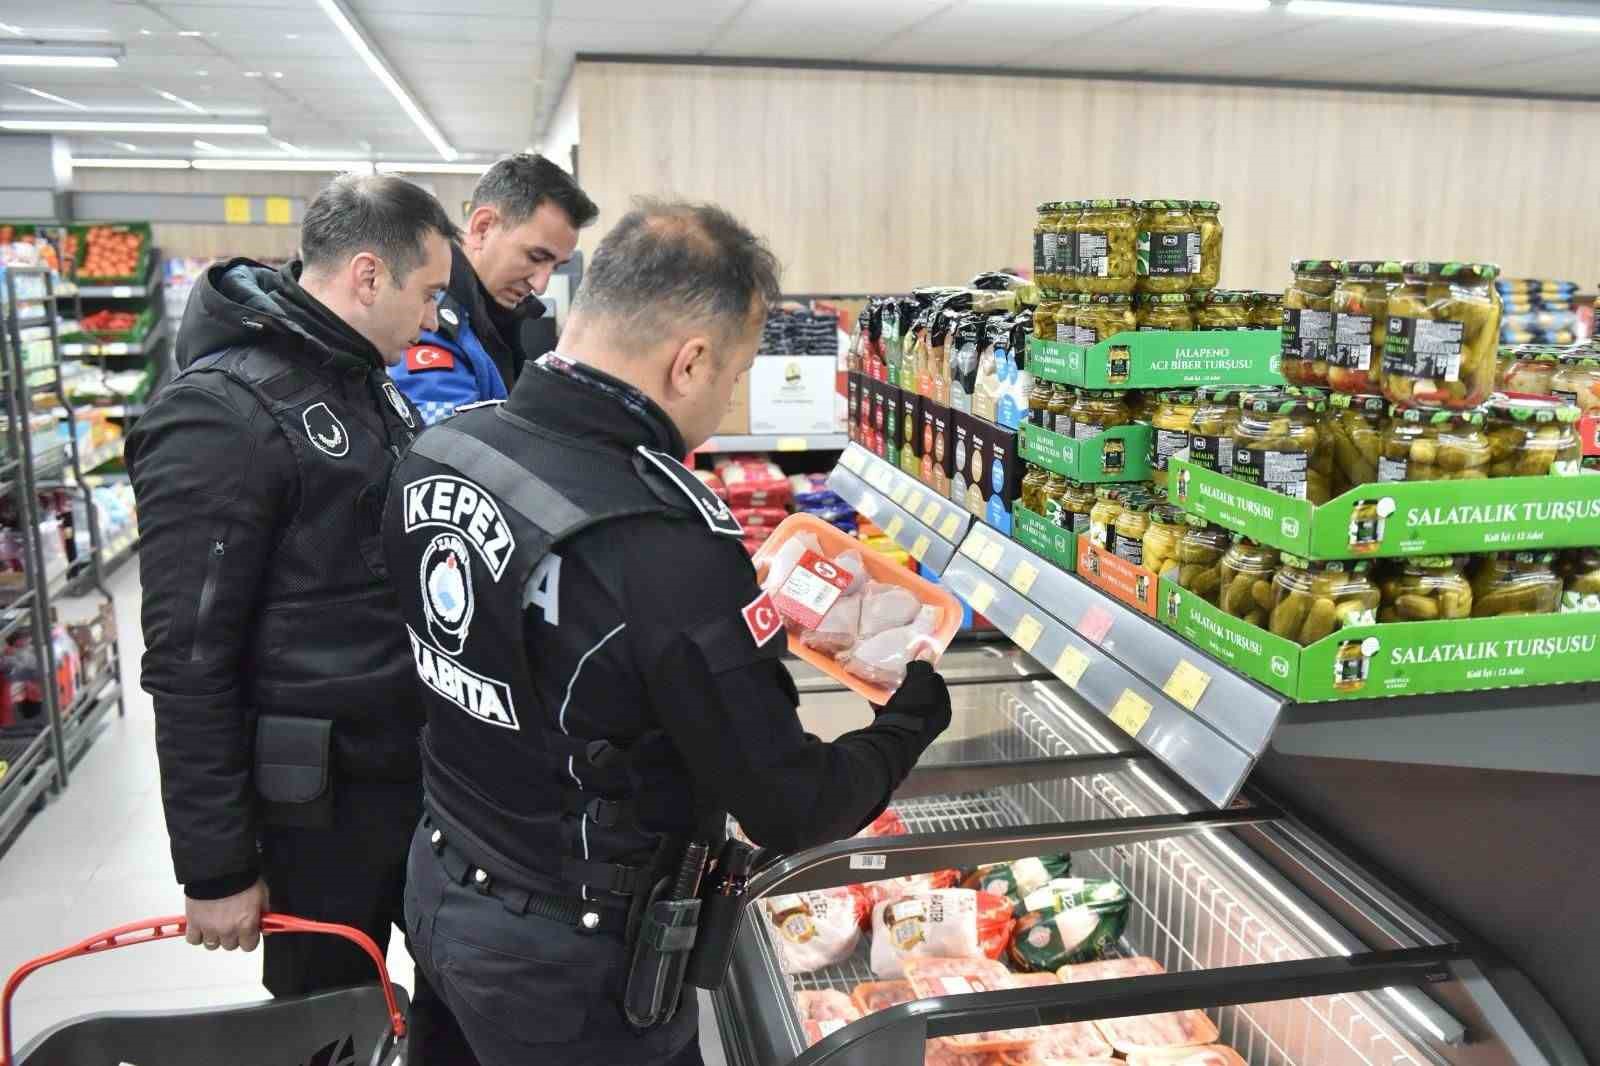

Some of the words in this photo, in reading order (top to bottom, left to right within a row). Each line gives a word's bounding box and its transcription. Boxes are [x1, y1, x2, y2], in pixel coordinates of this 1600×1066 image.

[1200, 483, 1235, 507] SALATALIK
[409, 482, 509, 571] KEPEZ
[1407, 503, 1519, 527] SALATALIK
[1191, 608, 1224, 638] SALATALIK
[1391, 641, 1500, 665] SALATALIK
[1504, 634, 1596, 659] TURŞUSU
